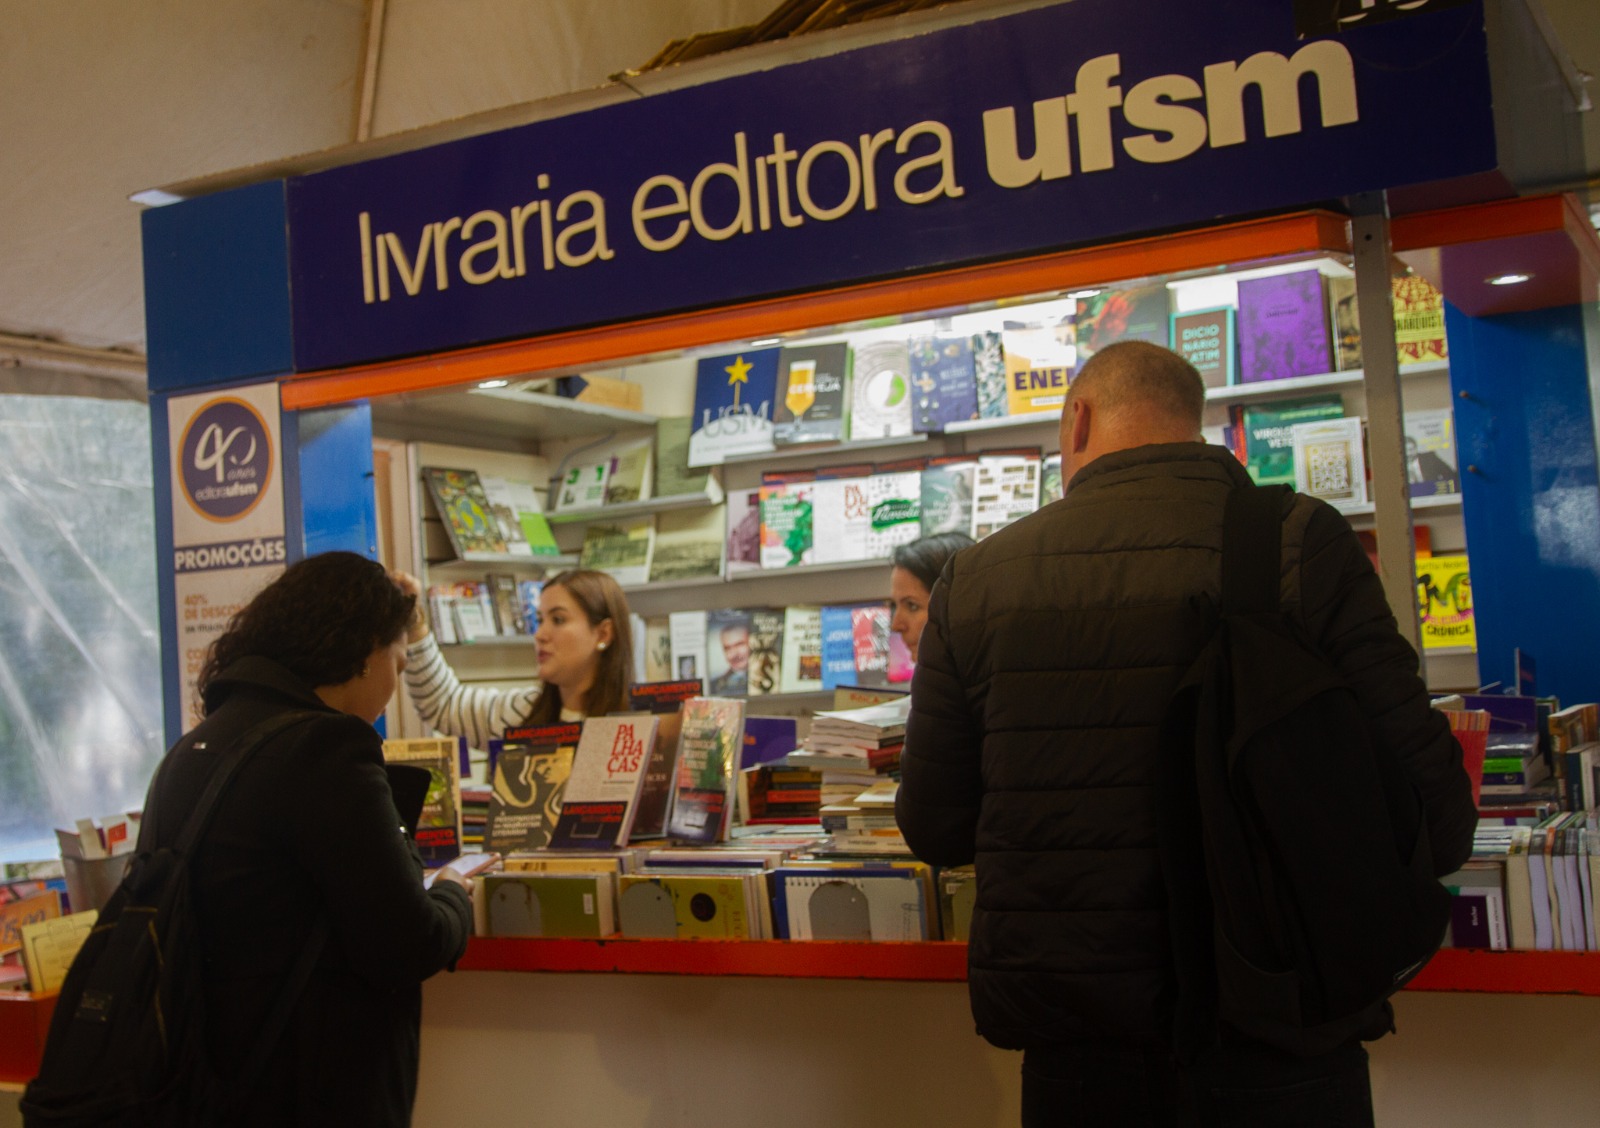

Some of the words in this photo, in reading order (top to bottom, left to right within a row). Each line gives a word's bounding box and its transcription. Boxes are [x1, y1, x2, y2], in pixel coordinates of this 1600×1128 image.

[359, 173, 615, 305] livraria
[631, 132, 964, 252] editora
[982, 39, 1360, 190] ufsm
[174, 539, 286, 569] PROMOÇÕES
[506, 724, 580, 740] LANÇAMENTO
[617, 724, 635, 740] PA
[611, 738, 644, 757] LHA
[606, 755, 640, 779] ÇAS
[563, 804, 624, 816] LANÇAMENTO
